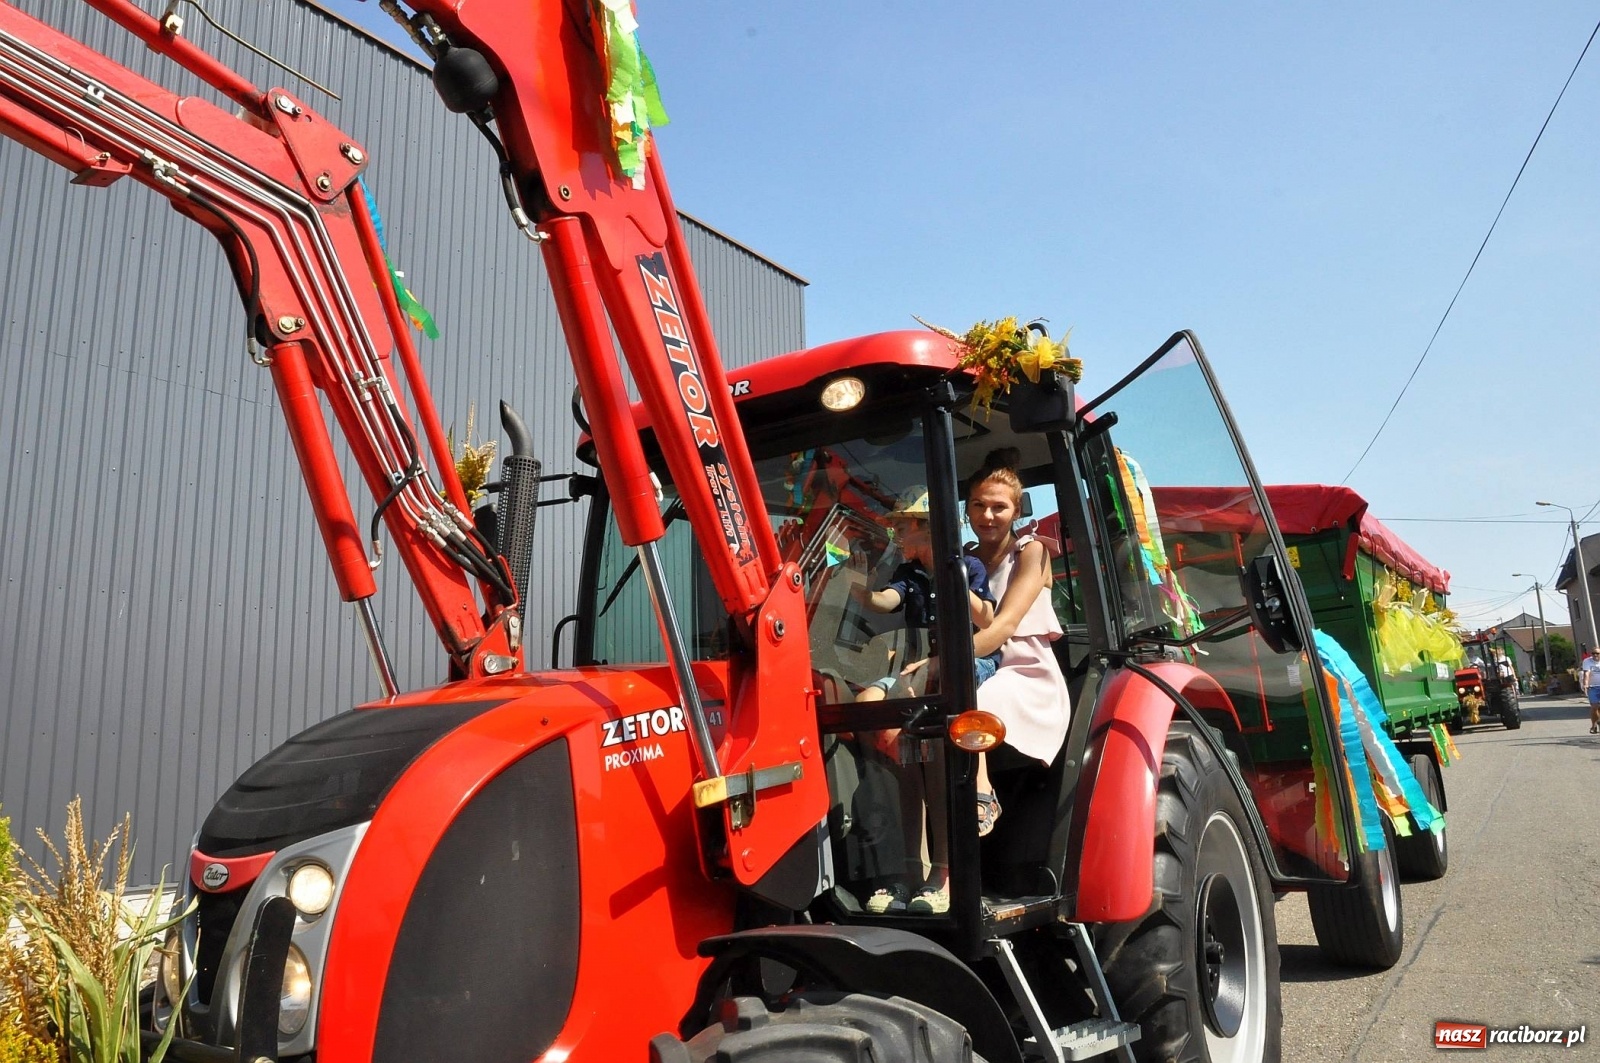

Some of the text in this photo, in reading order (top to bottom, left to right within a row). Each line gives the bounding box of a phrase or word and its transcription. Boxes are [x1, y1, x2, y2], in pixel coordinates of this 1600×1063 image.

[640, 263, 719, 448] ZETOR
[602, 706, 686, 748] ZETOR
[604, 743, 664, 772] PROXIMA
